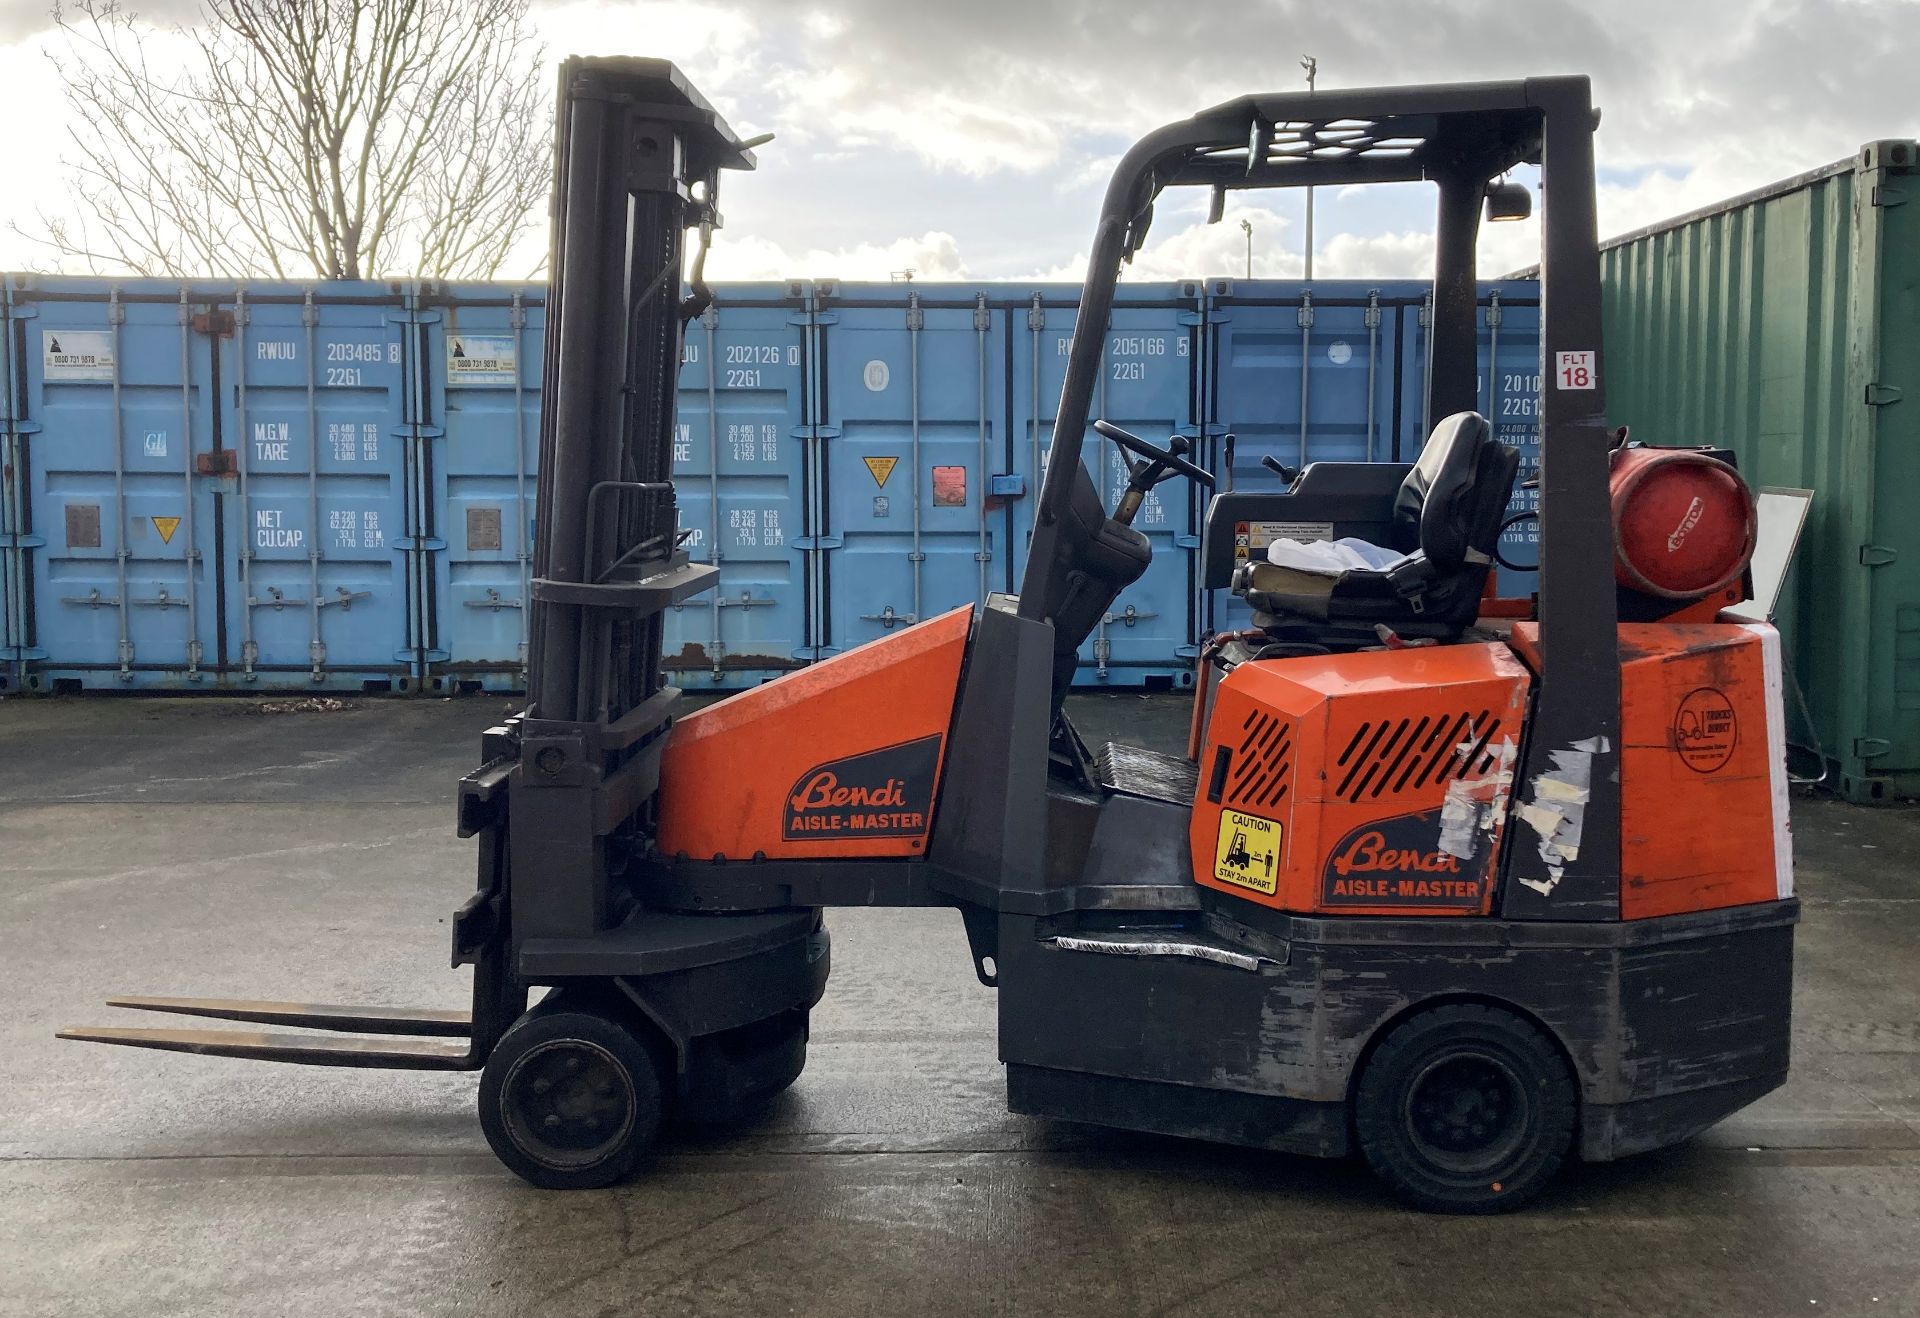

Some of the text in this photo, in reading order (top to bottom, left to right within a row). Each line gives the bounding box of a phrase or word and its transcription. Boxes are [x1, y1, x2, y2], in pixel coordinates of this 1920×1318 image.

[257, 342, 399, 362] RWUU 203485 8
[726, 345, 779, 364] 202126
[1112, 338, 1188, 356] 205166 5
[1563, 354, 1588, 365] FLT
[327, 368, 361, 386] 22G1
[727, 370, 761, 387] 22G1
[1113, 362, 1145, 380] 22G1
[1562, 367, 1589, 387] 18
[1504, 374, 1540, 392] 2010
[1503, 398, 1538, 415] 22G1
[255, 423, 292, 441] M.G.W.
[363, 423, 377, 433] KGS
[762, 424, 777, 434] KGS
[363, 432, 377, 442] LBS
[762, 433, 777, 443] LBS
[255, 443, 289, 461] TARE
[762, 442, 777, 452] KGS
[762, 451, 777, 461] LBS
[1145, 497, 1159, 505] LBS
[256, 511, 283, 528] NET
[364, 511, 378, 521] KGS
[763, 510, 778, 519] KGS
[364, 520, 378, 530] LBS
[763, 519, 778, 528] LBS
[791, 771, 906, 813] Bendi
[791, 813, 923, 831] AISLE-MASTER
[1232, 814, 1271, 833] CAUTION
[1219, 868, 1271, 890] STAY 2m APART
[1332, 880, 1480, 897] AISLE-MASTER
